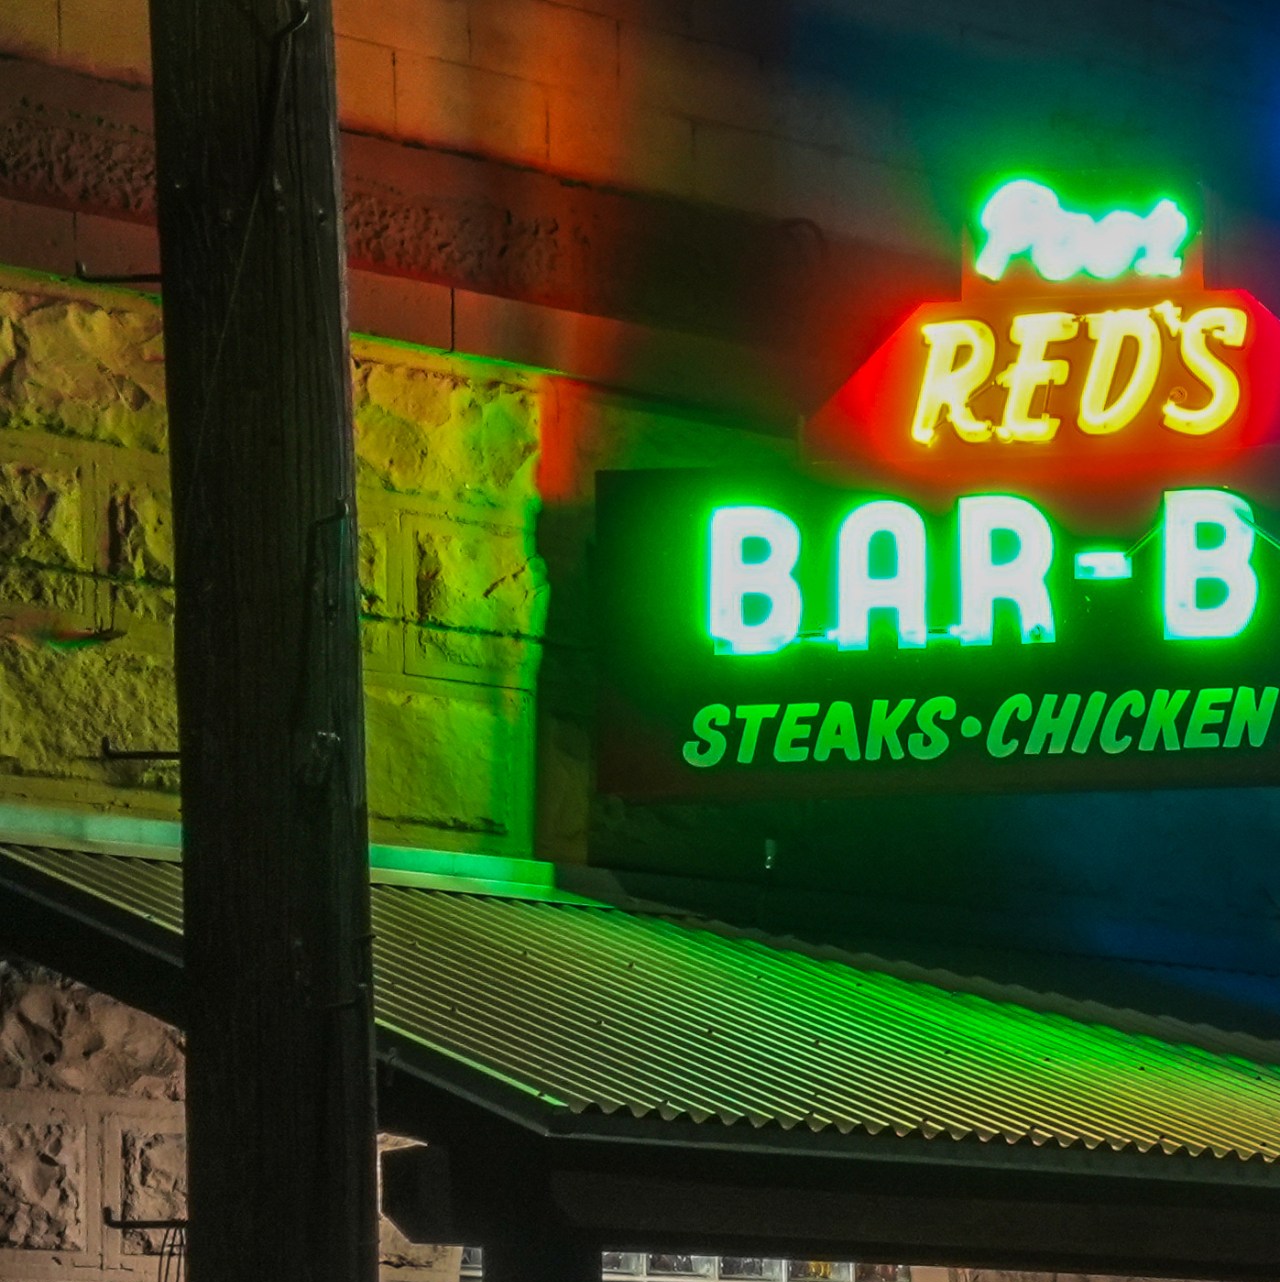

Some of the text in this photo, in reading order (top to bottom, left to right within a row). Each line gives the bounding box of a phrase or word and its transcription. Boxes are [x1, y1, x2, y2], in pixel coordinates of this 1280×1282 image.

[911, 301, 1247, 446] RED'S
[683, 696, 956, 768] STEAKS
[986, 686, 1280, 758] CHICKEN
